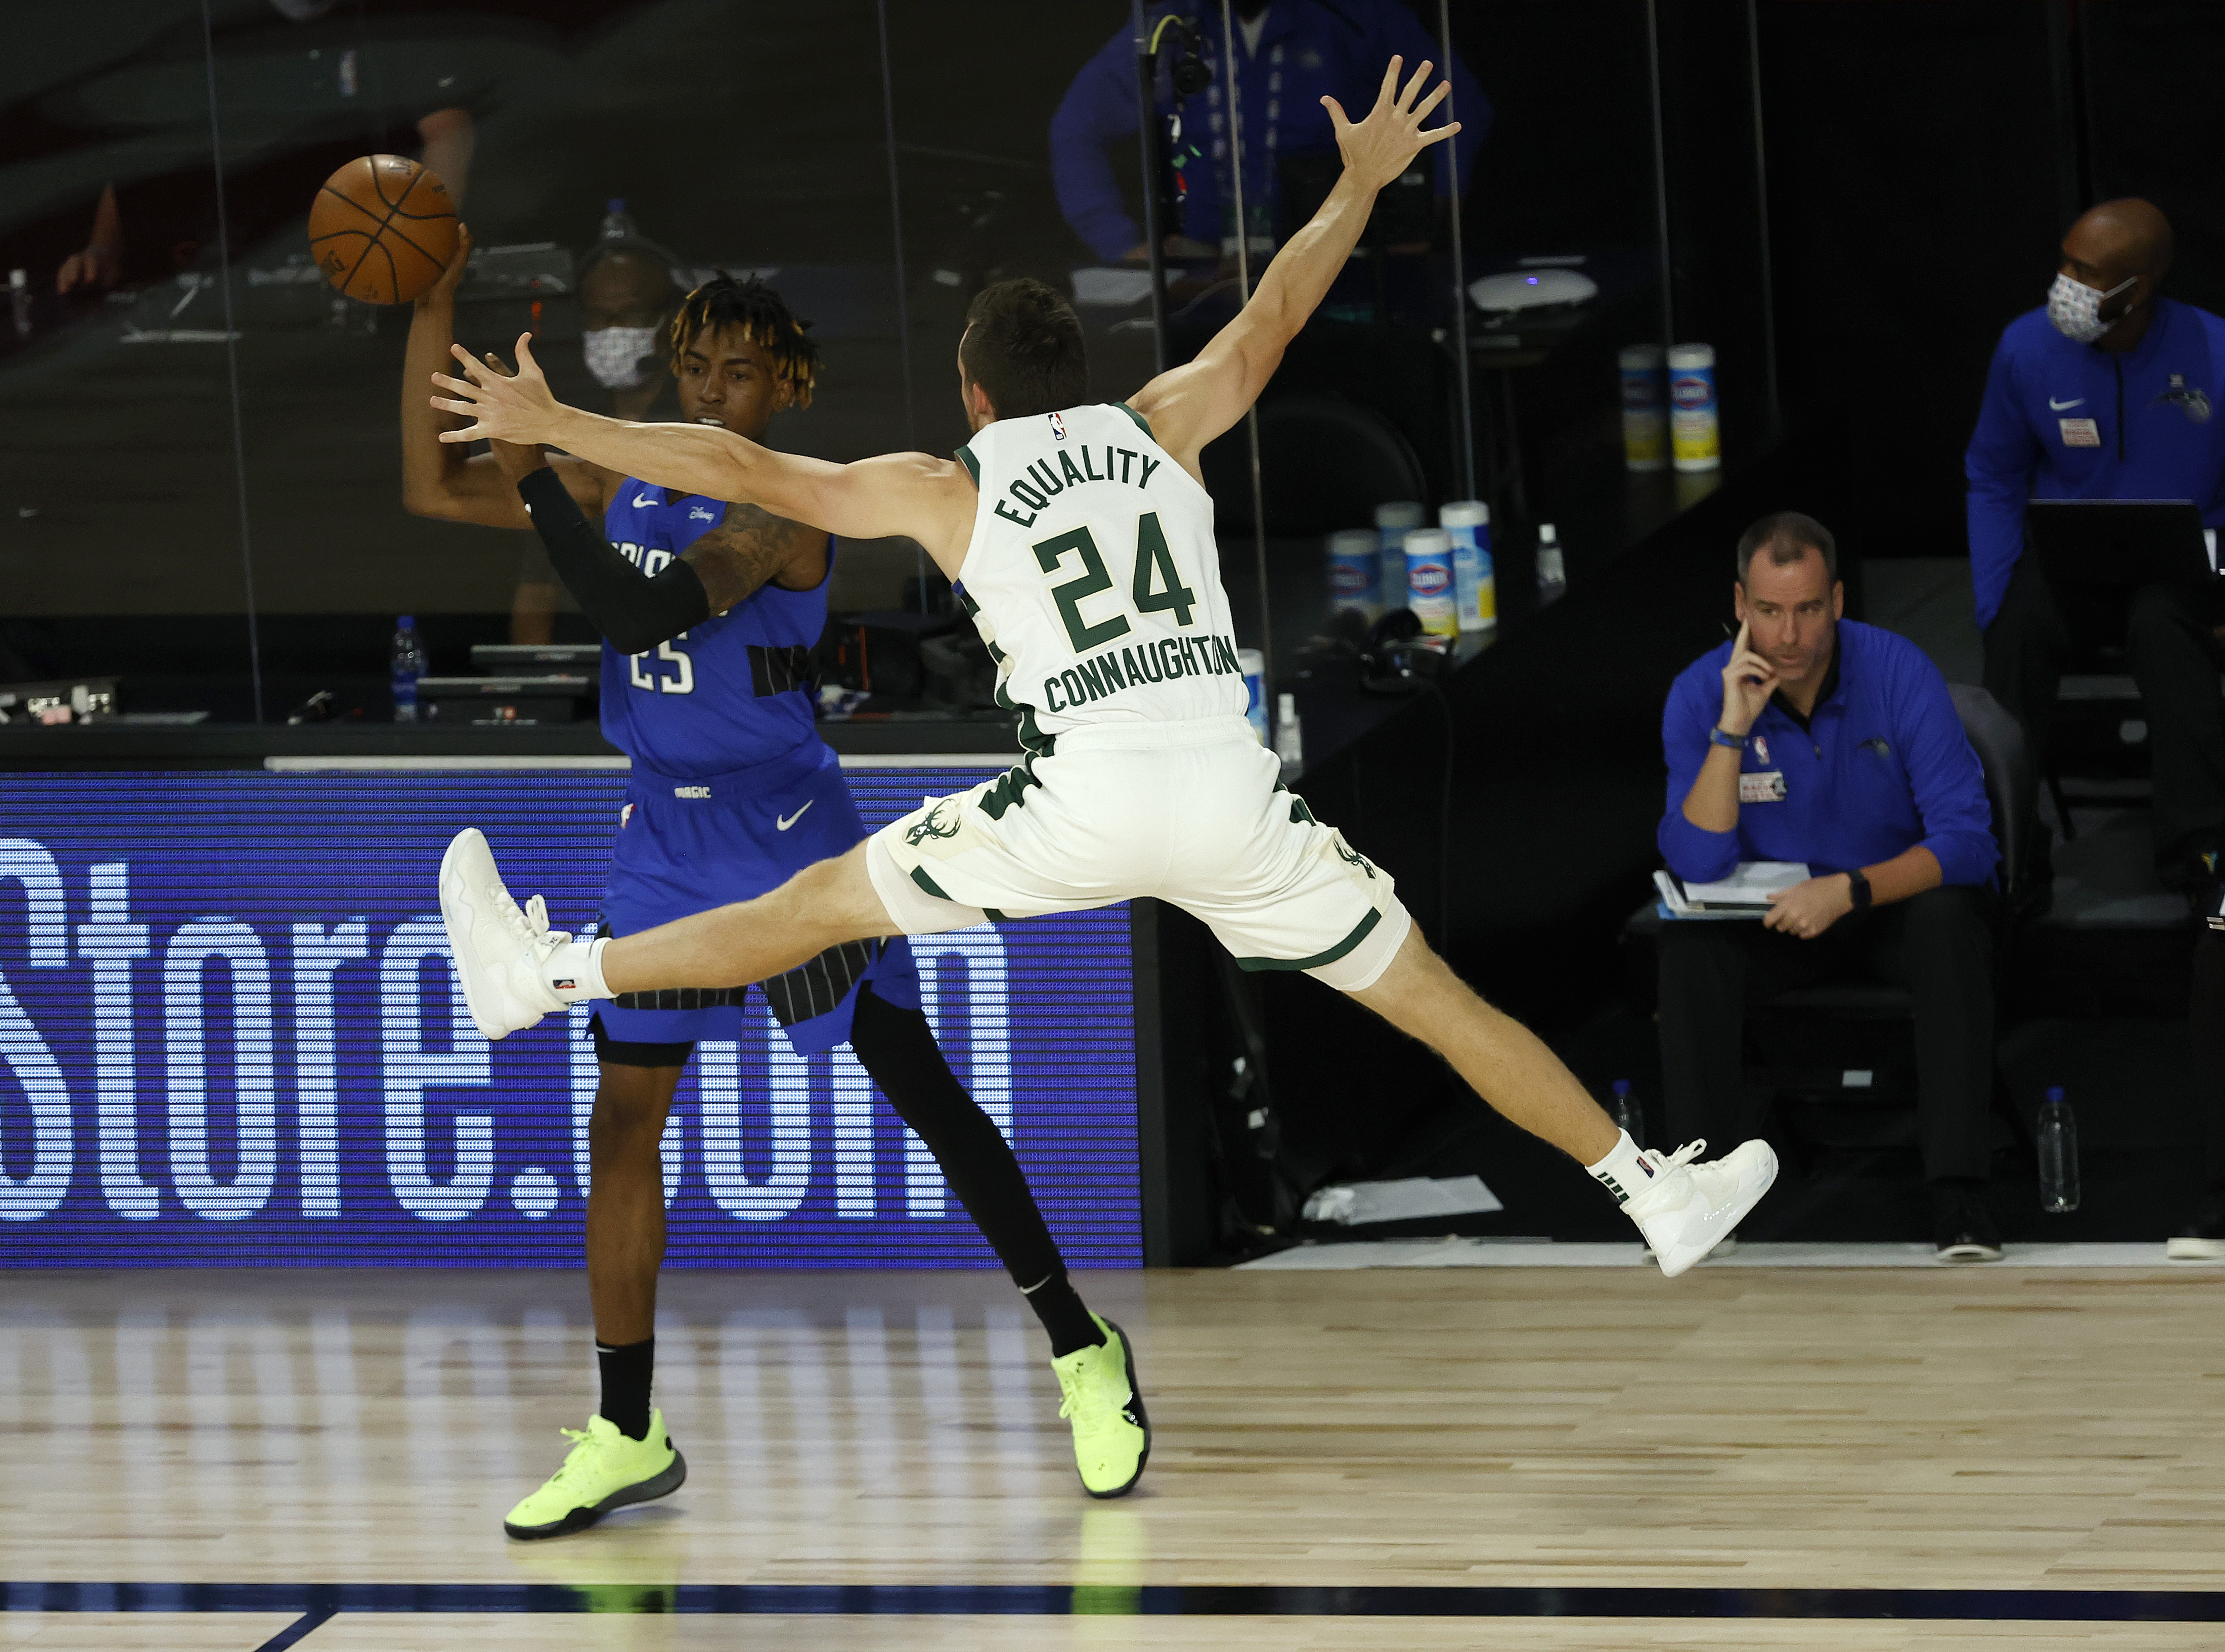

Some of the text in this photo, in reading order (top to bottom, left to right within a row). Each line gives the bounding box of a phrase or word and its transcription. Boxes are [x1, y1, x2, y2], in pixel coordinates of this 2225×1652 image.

[994, 445, 1160, 528] EQUALITY
[1030, 510, 1197, 656] 24
[1044, 634, 1241, 712] CONNAUGHTON
